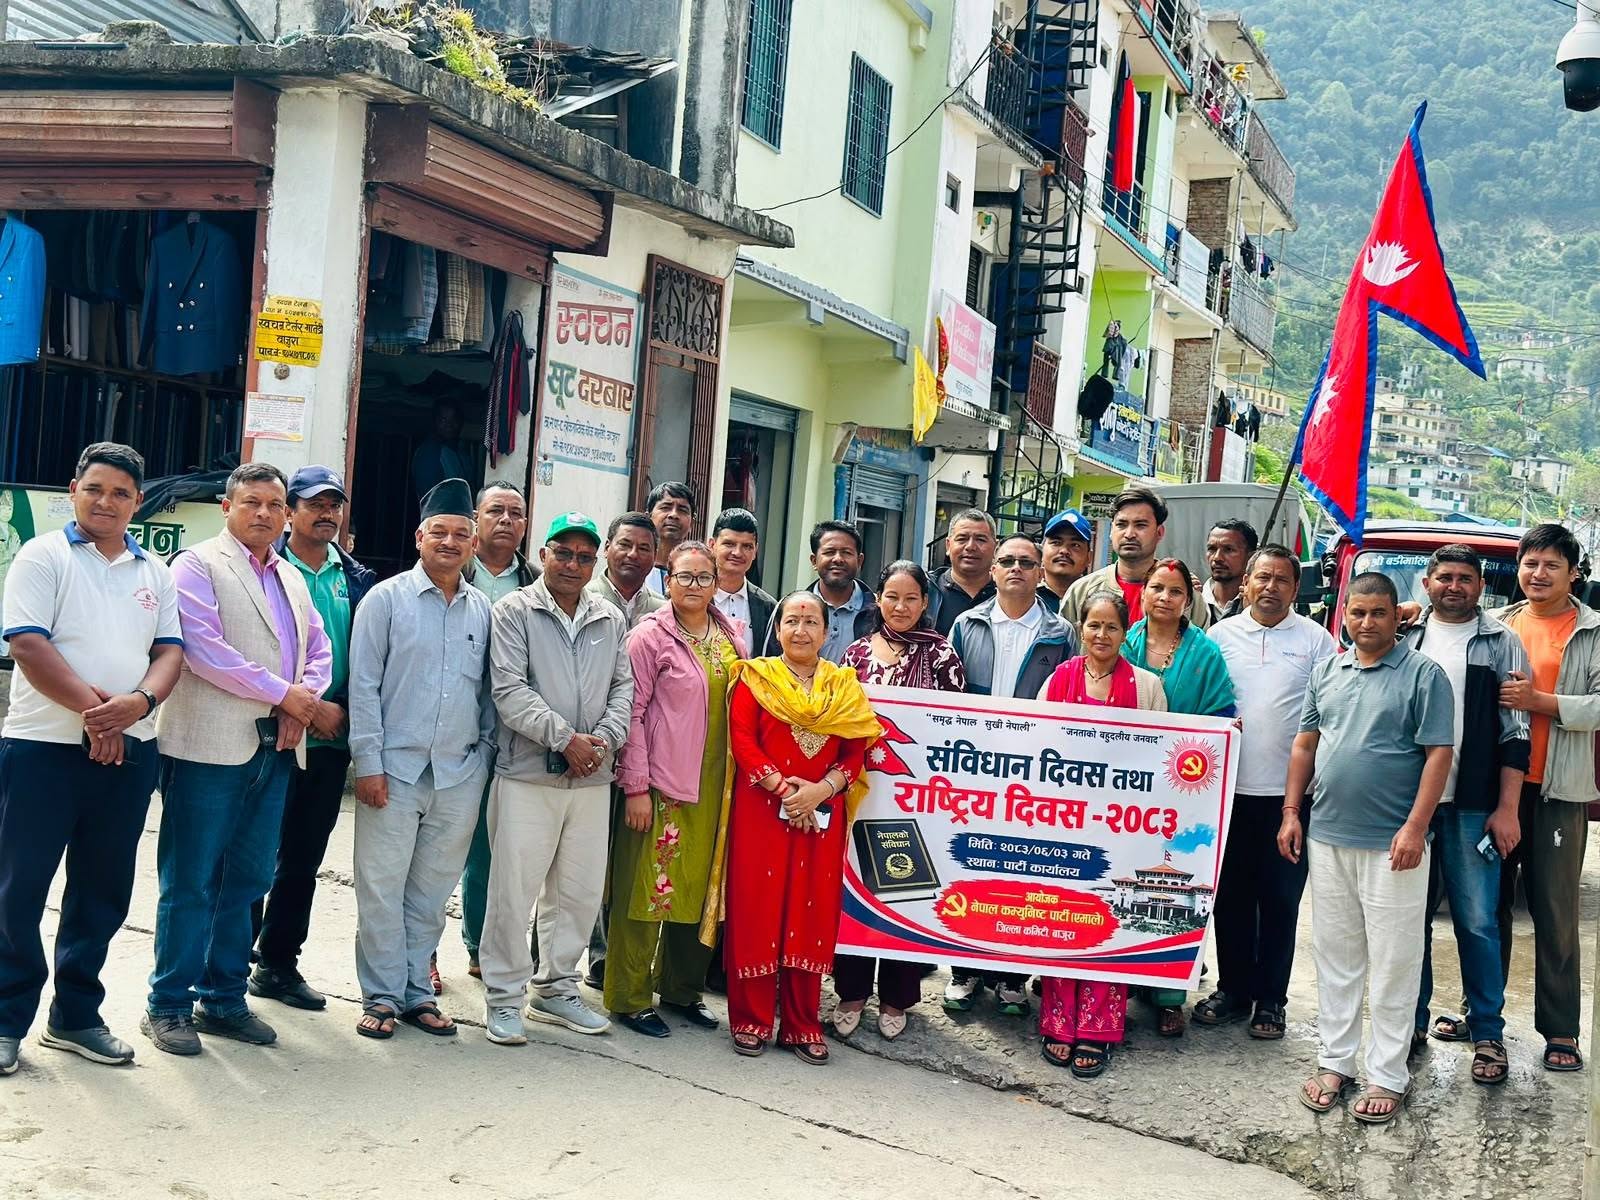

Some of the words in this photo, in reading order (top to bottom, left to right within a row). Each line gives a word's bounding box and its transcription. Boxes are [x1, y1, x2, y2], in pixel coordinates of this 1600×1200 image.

[557, 301, 635, 348] स्वचन
[547, 360, 578, 410] सूट
[578, 368, 635, 413] दरबार
[127, 522, 185, 556] चन
[1386, 555, 1431, 567] बडीमालि
[926, 713, 953, 727] “समृद्ध
[956, 714, 977, 726] नेपाल
[985, 719, 1003, 731] सुखी
[1005, 720, 1036, 732] नेपाली”
[1061, 726, 1097, 739] “जनताको
[1133, 735, 1164, 745] जनवाद”
[926, 740, 1033, 781] संविधान
[1039, 748, 1109, 788] दिवस
[1112, 768, 1154, 793] तथा
[894, 775, 998, 825] राष्ट्रिय
[1004, 783, 1088, 829] दिवस
[1092, 803, 1179, 840] -२०८३
[877, 830, 909, 840] नेपालको
[881, 840, 911, 850] संविधान
[1000, 842, 1069, 860] २०८३/०६/०३
[1072, 848, 1092, 861] गते
[966, 856, 1000, 869] स्थान:
[1003, 859, 1027, 872] पार्टी
[1030, 863, 1081, 878] कार्यालय
[1025, 890, 1059, 905] आयोजक
[971, 899, 999, 915] नेपाल
[1001, 905, 1049, 921] कम्युनिष्ट
[1049, 908, 1070, 922] पार्टी
[1071, 912, 1105, 926] (एमाले)
[996, 921, 1021, 935] जिल्ला
[1052, 929, 1076, 941] बाजुरा
